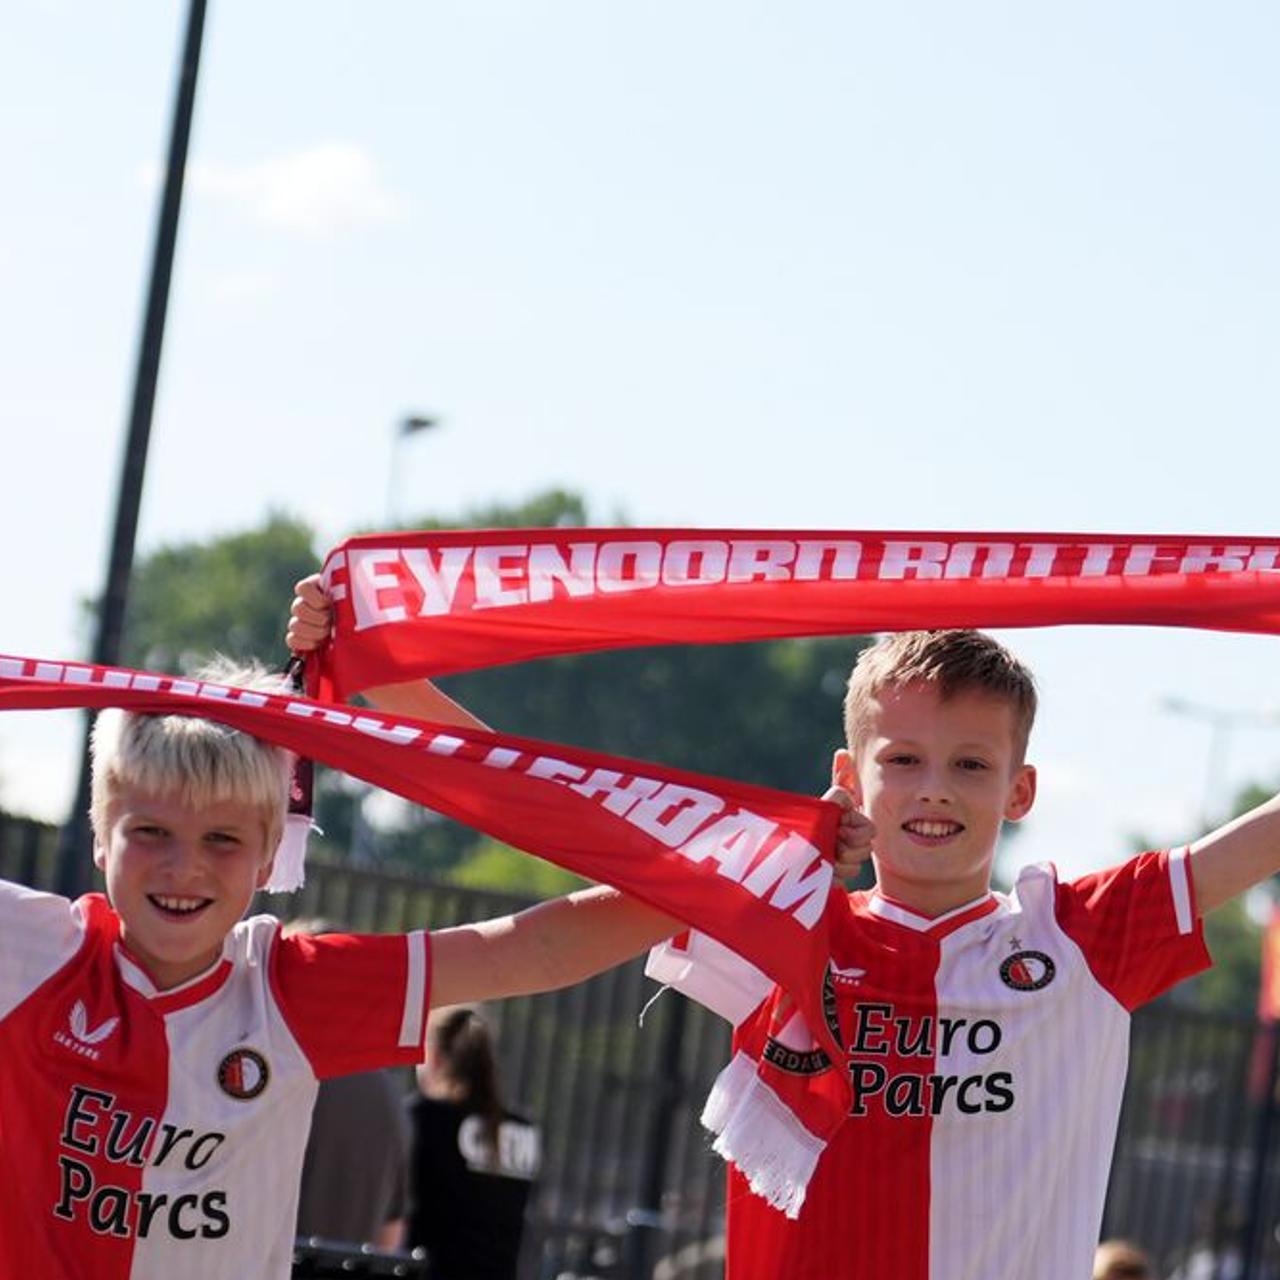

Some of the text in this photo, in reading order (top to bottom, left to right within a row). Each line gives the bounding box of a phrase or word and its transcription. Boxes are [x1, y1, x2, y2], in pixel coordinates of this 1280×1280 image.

[850, 1003, 1003, 1057] Euro
[847, 1060, 1015, 1117] Parcs
[61, 1084, 226, 1171] Euro
[53, 1155, 231, 1240] Parcs
